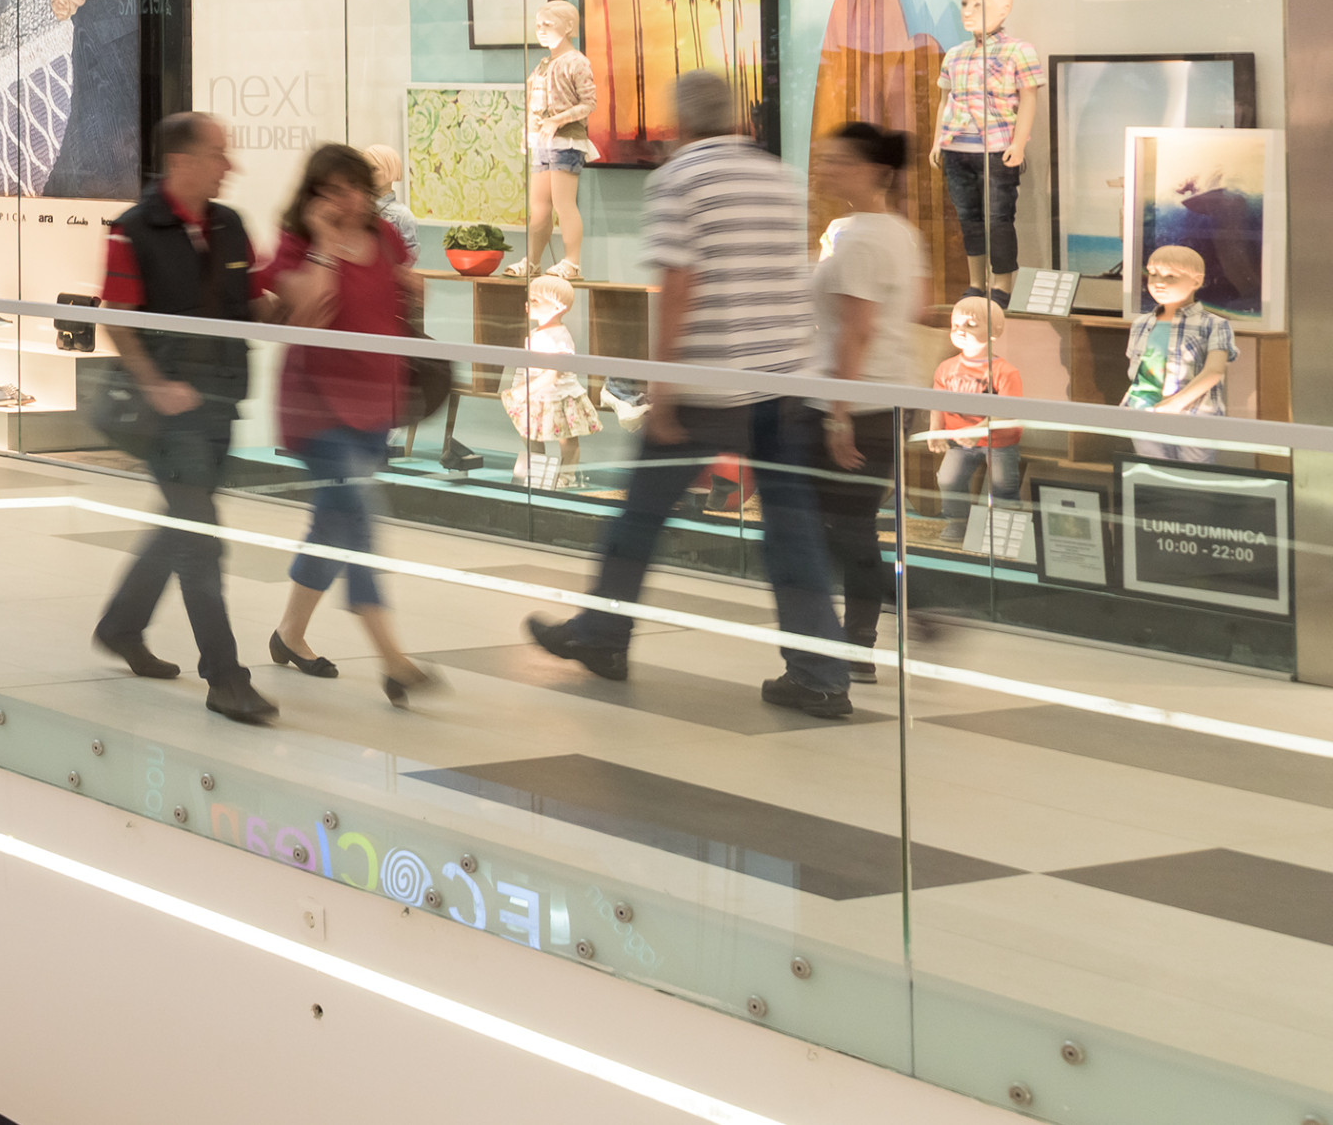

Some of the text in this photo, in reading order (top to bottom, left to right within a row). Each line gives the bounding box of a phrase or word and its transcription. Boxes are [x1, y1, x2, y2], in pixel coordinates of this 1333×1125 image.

[209, 70, 327, 117] next
[225, 125, 317, 151] HILDREN
[38, 214, 54, 223] ara
[1142, 518, 1268, 546] LUNI-DUMINICA
[1157, 538, 1198, 555] 10:00
[1212, 544, 1255, 562] 22:00
